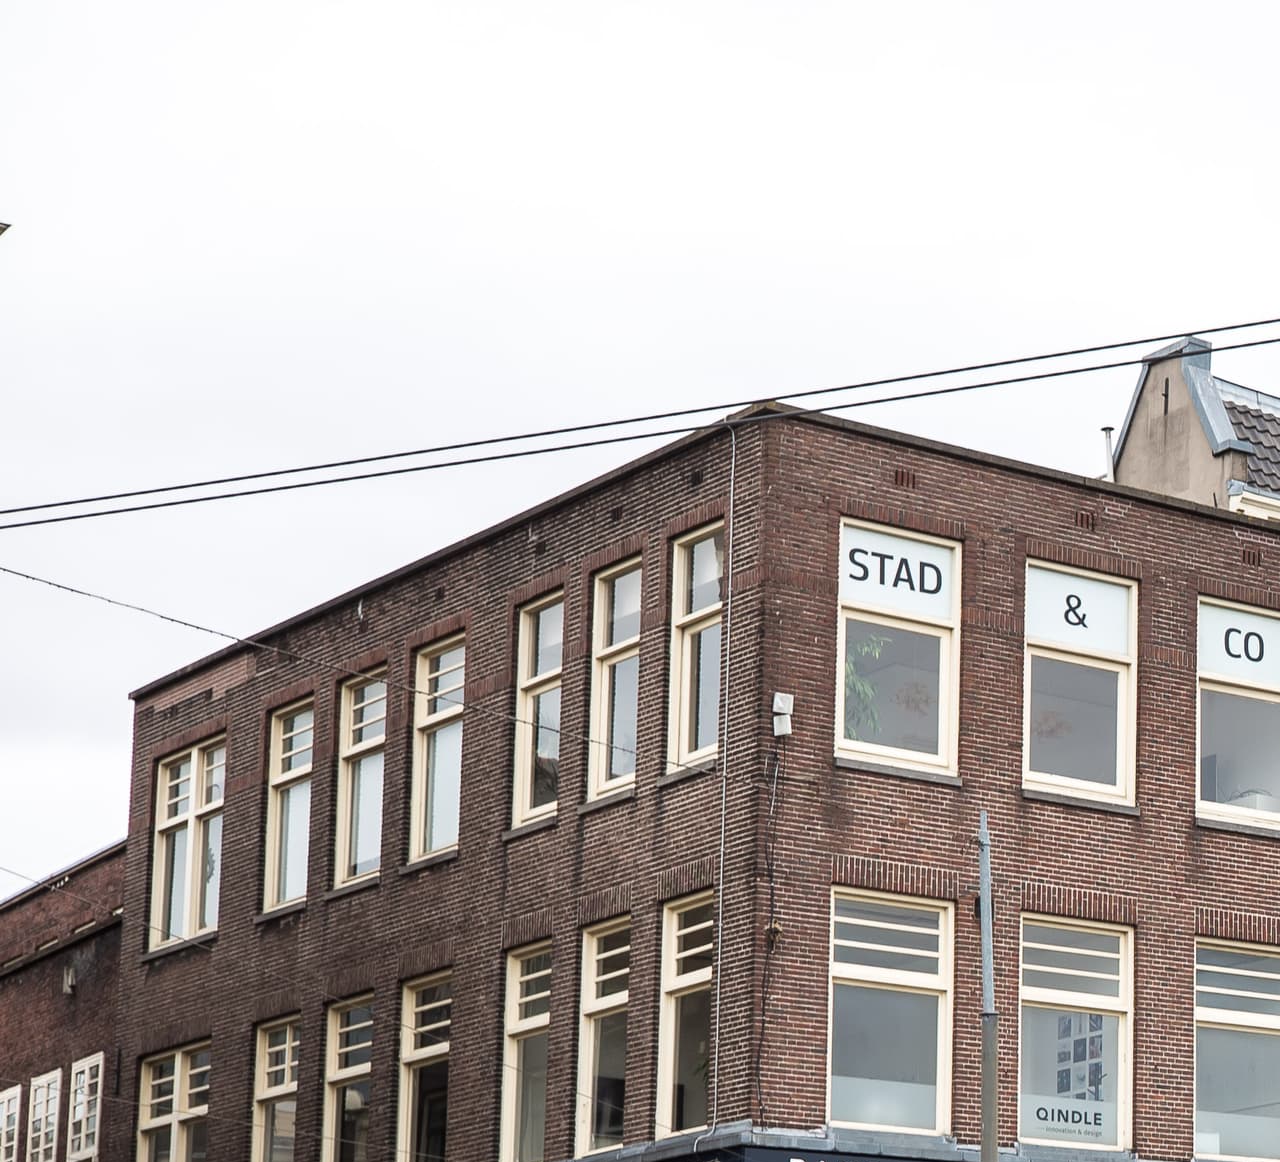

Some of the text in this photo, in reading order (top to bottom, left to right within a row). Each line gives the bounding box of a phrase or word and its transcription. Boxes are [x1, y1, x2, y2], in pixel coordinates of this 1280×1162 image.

[848, 547, 1265, 662] STAD & CO
[1036, 1106, 1103, 1126] QINDLE
[1084, 1129, 1102, 1138] design
